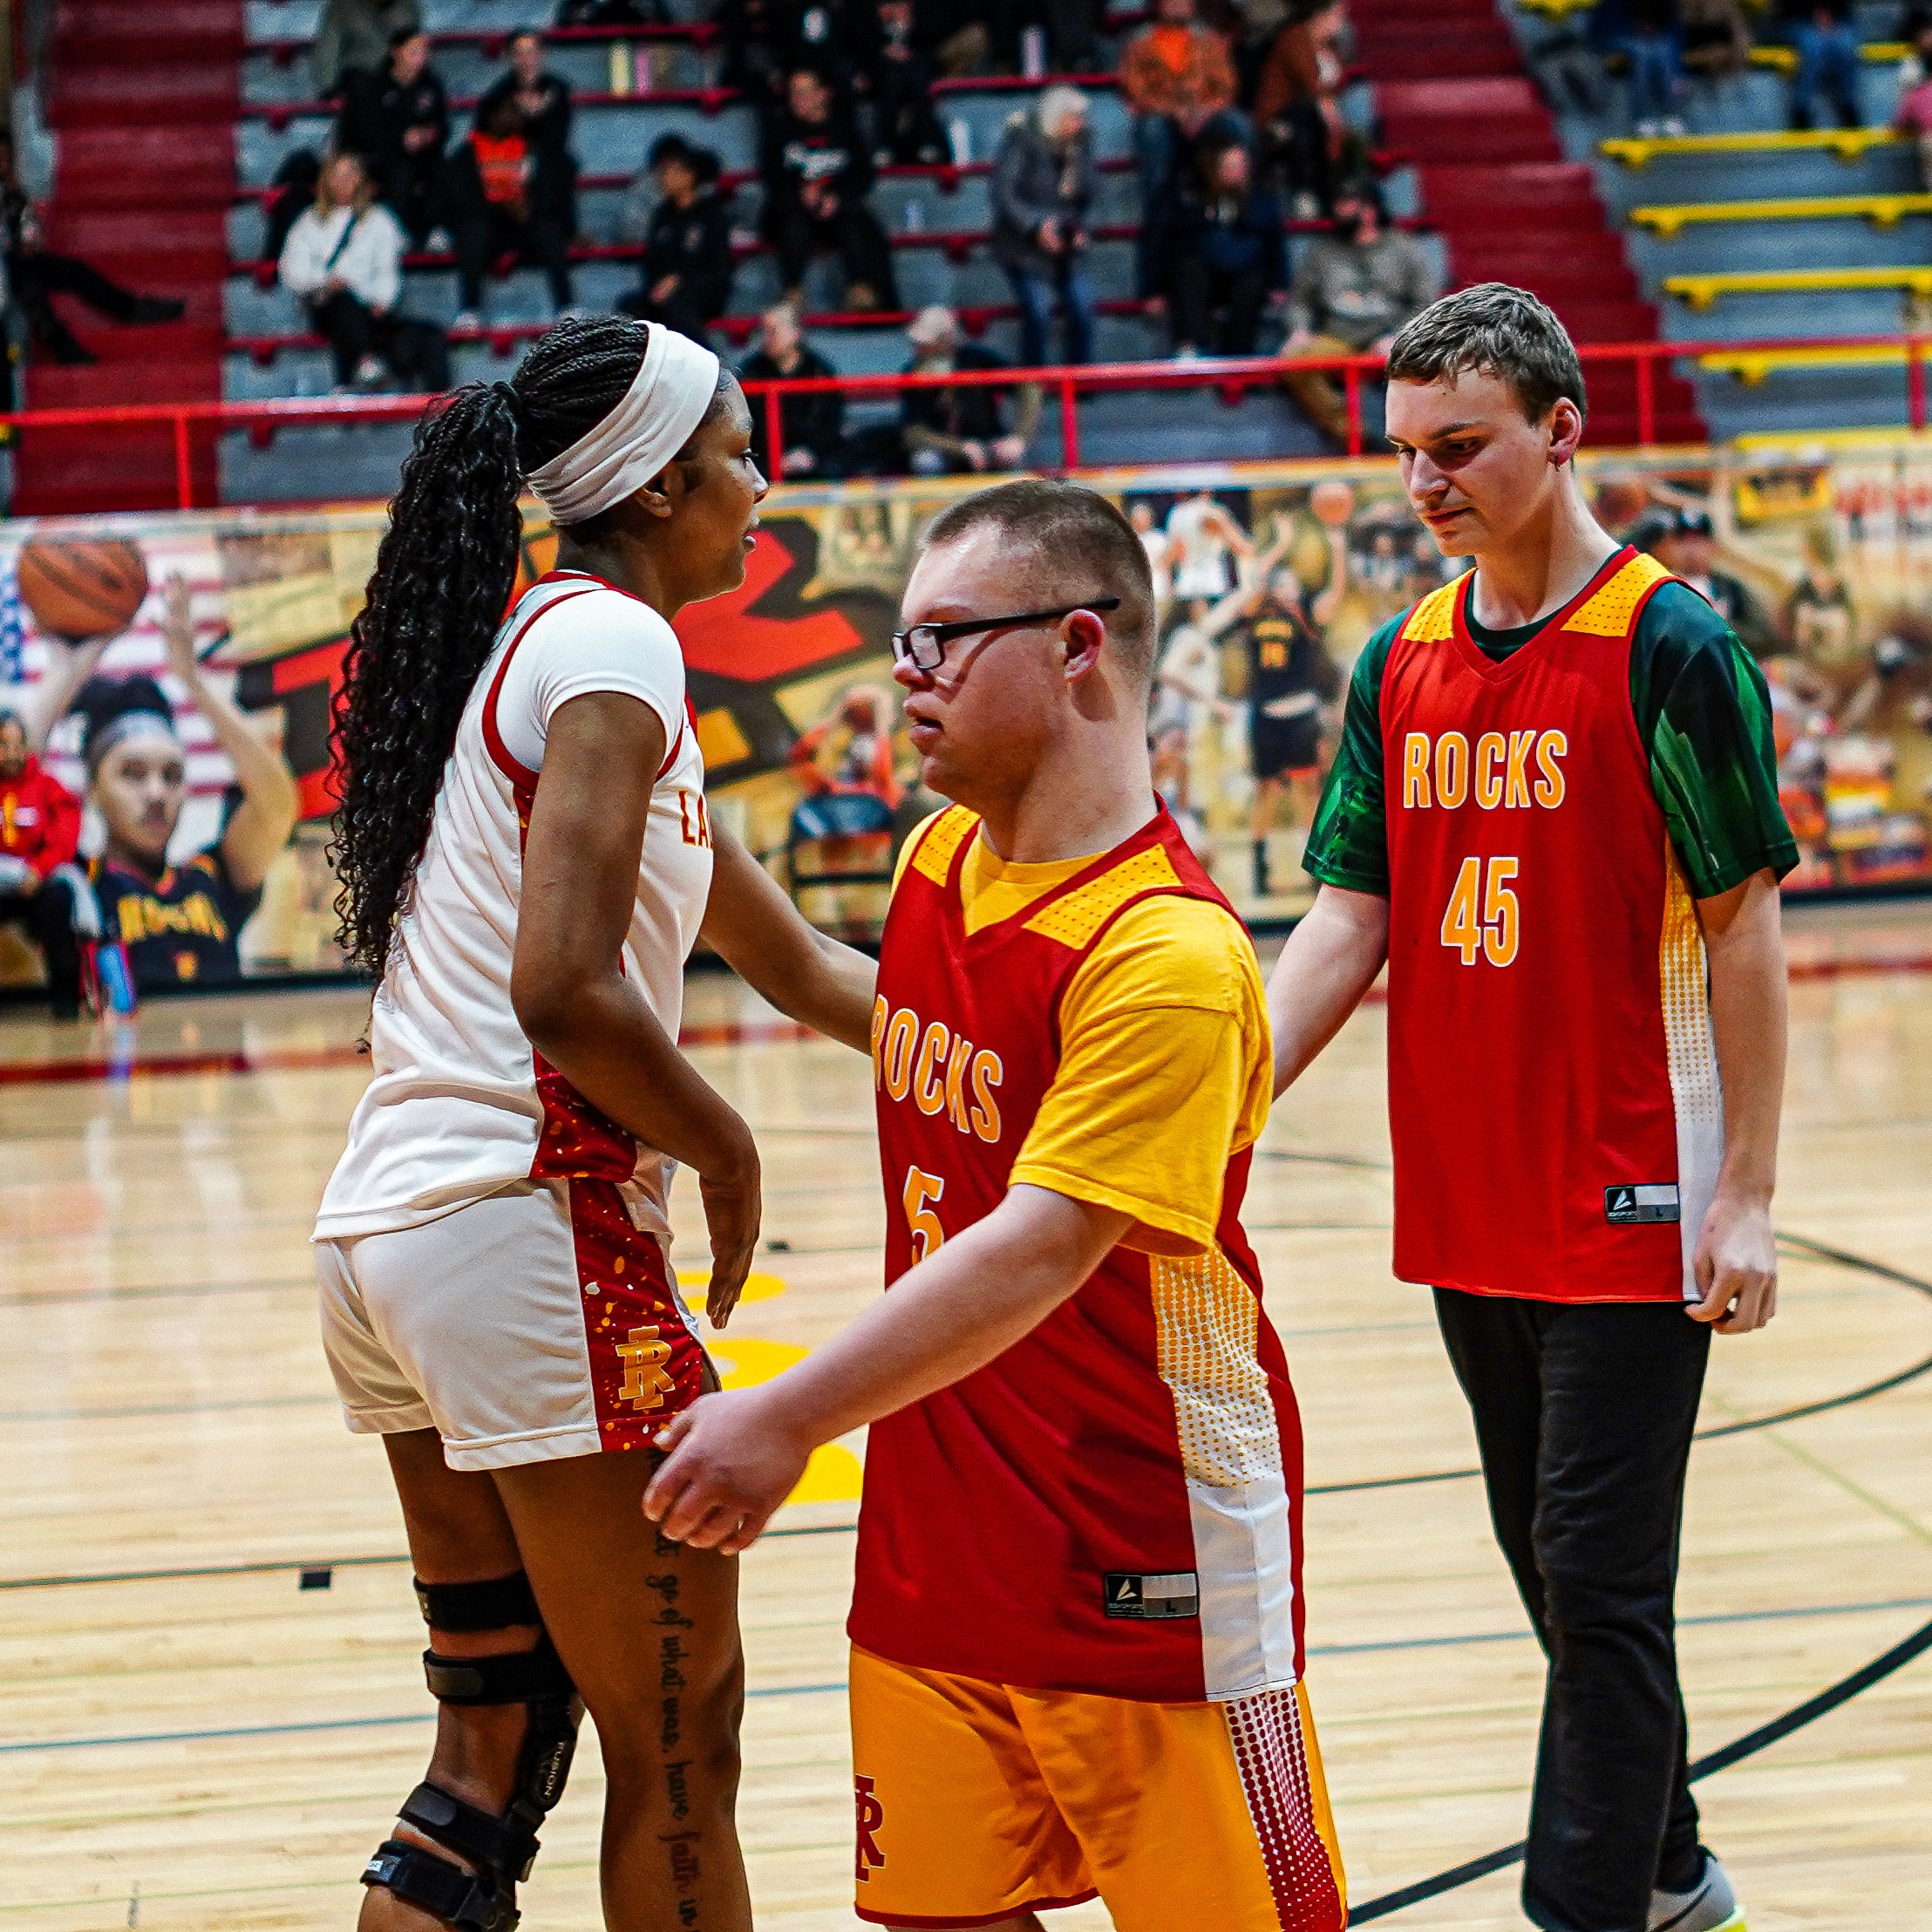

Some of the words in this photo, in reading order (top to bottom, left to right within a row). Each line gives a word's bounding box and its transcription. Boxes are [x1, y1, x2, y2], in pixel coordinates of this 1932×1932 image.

[1403, 730, 1568, 809] ROCKS
[677, 790, 713, 849] LA
[1441, 857, 1520, 967] 45
[870, 993, 1003, 1143] ROCKS
[903, 1165, 945, 1266] 5
[651, 1607, 694, 1629] of
[1165, 1601, 1176, 1613] L
[661, 1636, 690, 1690] what
[543, 1742, 565, 1797] FUSION
[663, 1759, 694, 1820] have
[658, 1831, 701, 1895] faith
